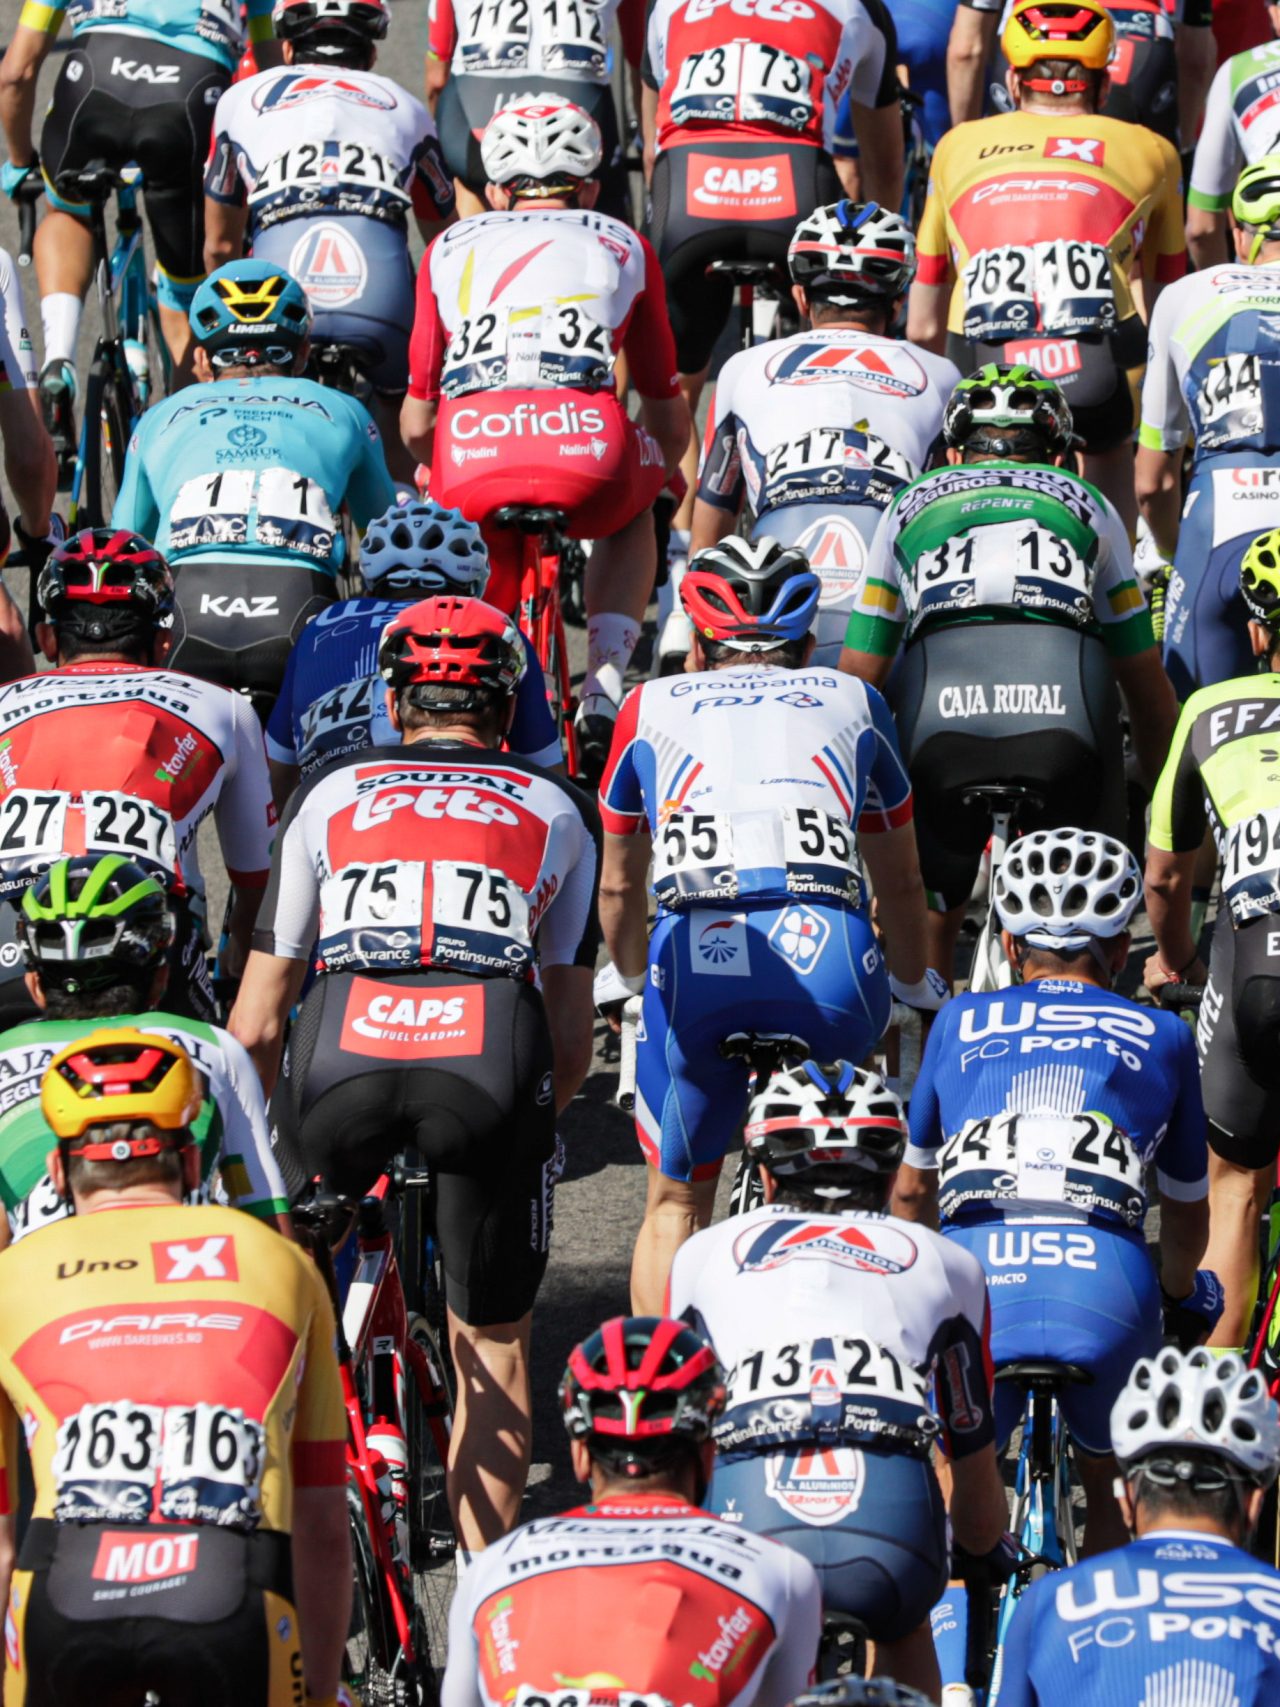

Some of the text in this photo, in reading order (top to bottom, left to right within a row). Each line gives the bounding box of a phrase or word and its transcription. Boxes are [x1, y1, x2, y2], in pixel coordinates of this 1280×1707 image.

[470, 1, 529, 38] 112
[111, 56, 180, 84] KAZ
[686, 47, 725, 91] 73
[760, 46, 801, 92] 73
[979, 142, 1034, 159] Uno
[703, 165, 778, 194] CAPS
[972, 179, 1100, 204] DARE
[228, 322, 278, 334] LIMAR
[453, 313, 496, 362] 32
[1015, 340, 1077, 373] MOT
[234, 409, 293, 420] PREMIER
[450, 401, 605, 440] Cofidis
[216, 447, 282, 460] SAMRUK
[467, 446, 497, 459] Nalini
[559, 443, 590, 456] Nalini
[769, 430, 840, 478] 217
[208, 475, 223, 507] 1
[295, 478, 309, 515] 1
[904, 476, 1002, 519] SEGUROS
[960, 498, 1035, 514] REPENTE
[1232, 491, 1279, 501] CASINO
[1015, 583, 1042, 593] GRUPO
[200, 594, 279, 617] KAZ
[670, 676, 838, 697] Groupama
[939, 684, 1066, 718] CAJA RURAL
[692, 695, 763, 715] FDJ
[165, 732, 197, 777] tavfer
[357, 772, 523, 801] SOUDAL
[0, 796, 60, 849] 27
[352, 789, 519, 831] Lotto
[664, 812, 718, 866] 55
[797, 809, 849, 862] 55
[342, 866, 398, 921] 75
[457, 869, 511, 927] 75
[322, 943, 348, 956] GRUPO
[437, 937, 466, 947] GRUPO
[325, 948, 411, 967] Portinsurance
[1038, 984, 1084, 993] PORTO
[368, 995, 464, 1026] CAPS
[381, 1030, 446, 1041] FUEL CARD
[960, 1035, 1142, 1072] FC Porto
[1064, 1181, 1093, 1192] GRUPO
[57, 1258, 139, 1281] Uno
[991, 1272, 1027, 1284] PACTO
[59, 1313, 243, 1345] DARE
[845, 1405, 877, 1416] GRUPO
[63, 1409, 152, 1472] 163
[600, 1504, 692, 1516] tavfer
[105, 1534, 199, 1582] MOT
[508, 1545, 742, 1580] mortágua
[93, 1576, 187, 1602] SHOW COURAGE!
[488, 1610, 516, 1673] tavfer
[702, 1606, 753, 1671] tavfer
[1067, 1615, 1136, 1664] FC
